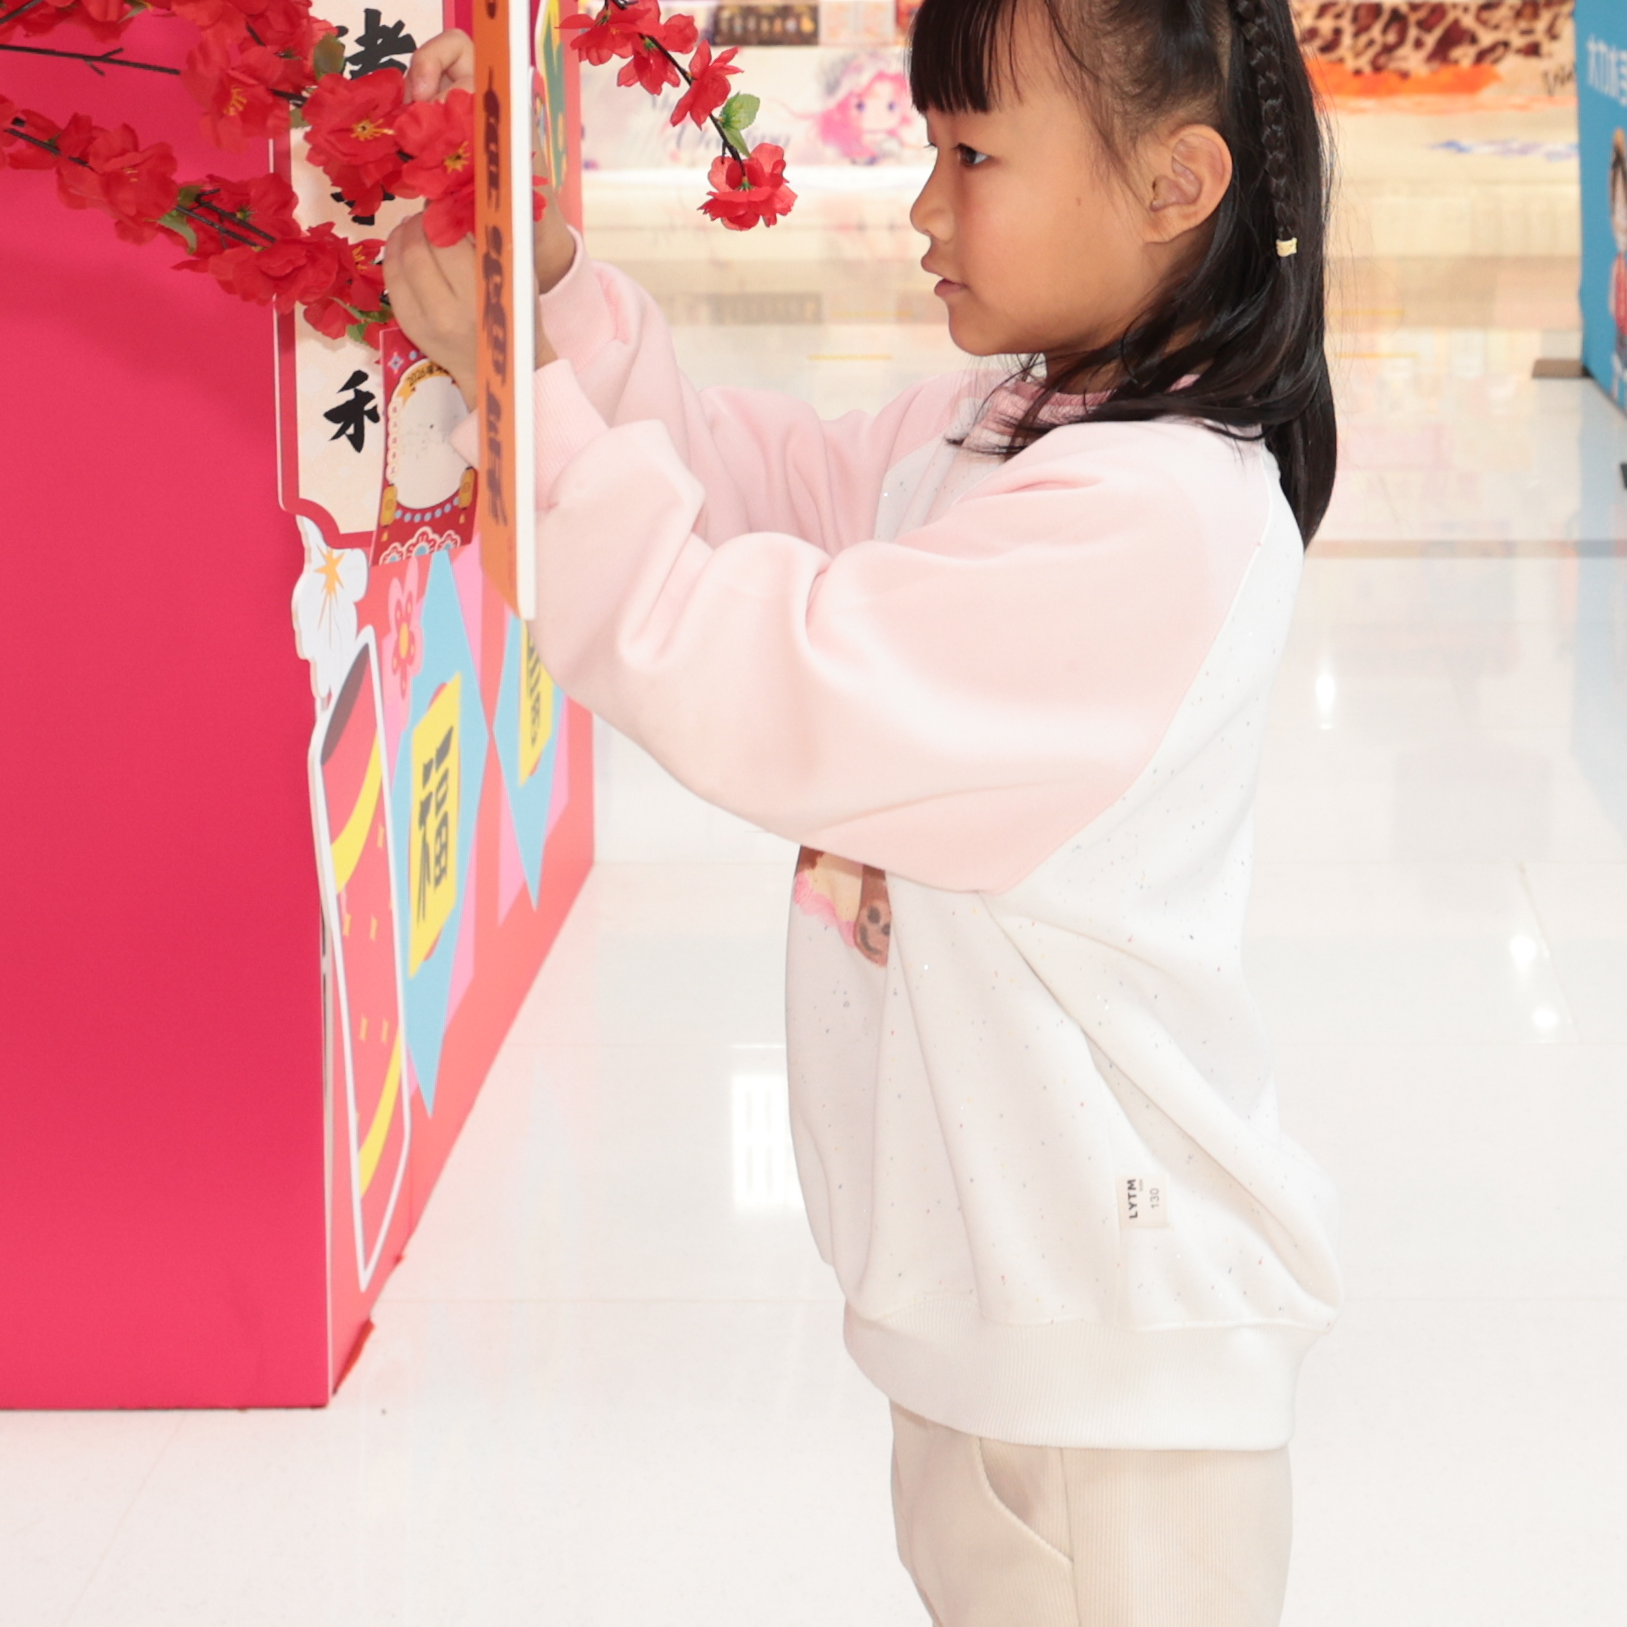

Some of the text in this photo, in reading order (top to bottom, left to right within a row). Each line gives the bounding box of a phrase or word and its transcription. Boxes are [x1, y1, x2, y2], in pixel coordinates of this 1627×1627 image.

[417, 726, 455, 927] 福
[1126, 1179, 1138, 1219] LYTM
[1149, 1188, 1160, 1209] 130
